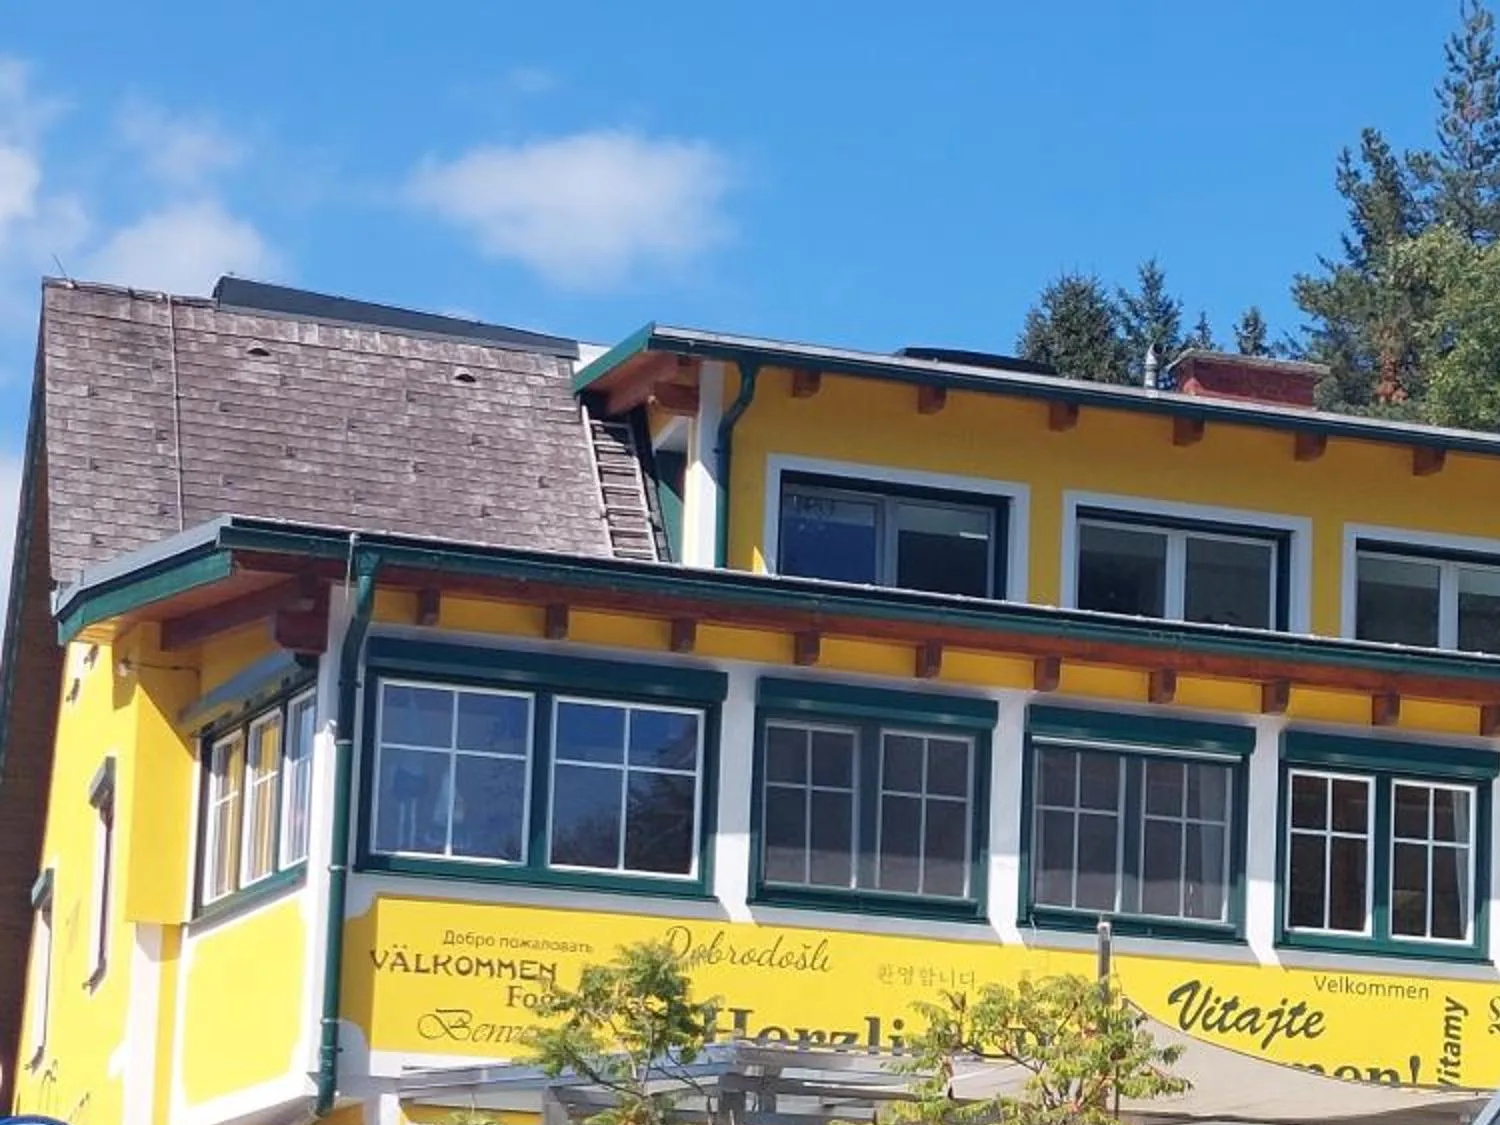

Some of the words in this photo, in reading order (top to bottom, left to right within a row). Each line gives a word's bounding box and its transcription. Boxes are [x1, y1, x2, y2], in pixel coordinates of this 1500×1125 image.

[443, 930, 496, 949] Добро
[499, 937, 593, 953] пожаловать
[370, 944, 557, 983] VÄLKOMMEN
[1313, 975, 1430, 1000] Velkommen
[1167, 979, 1327, 1050] Vitajte
